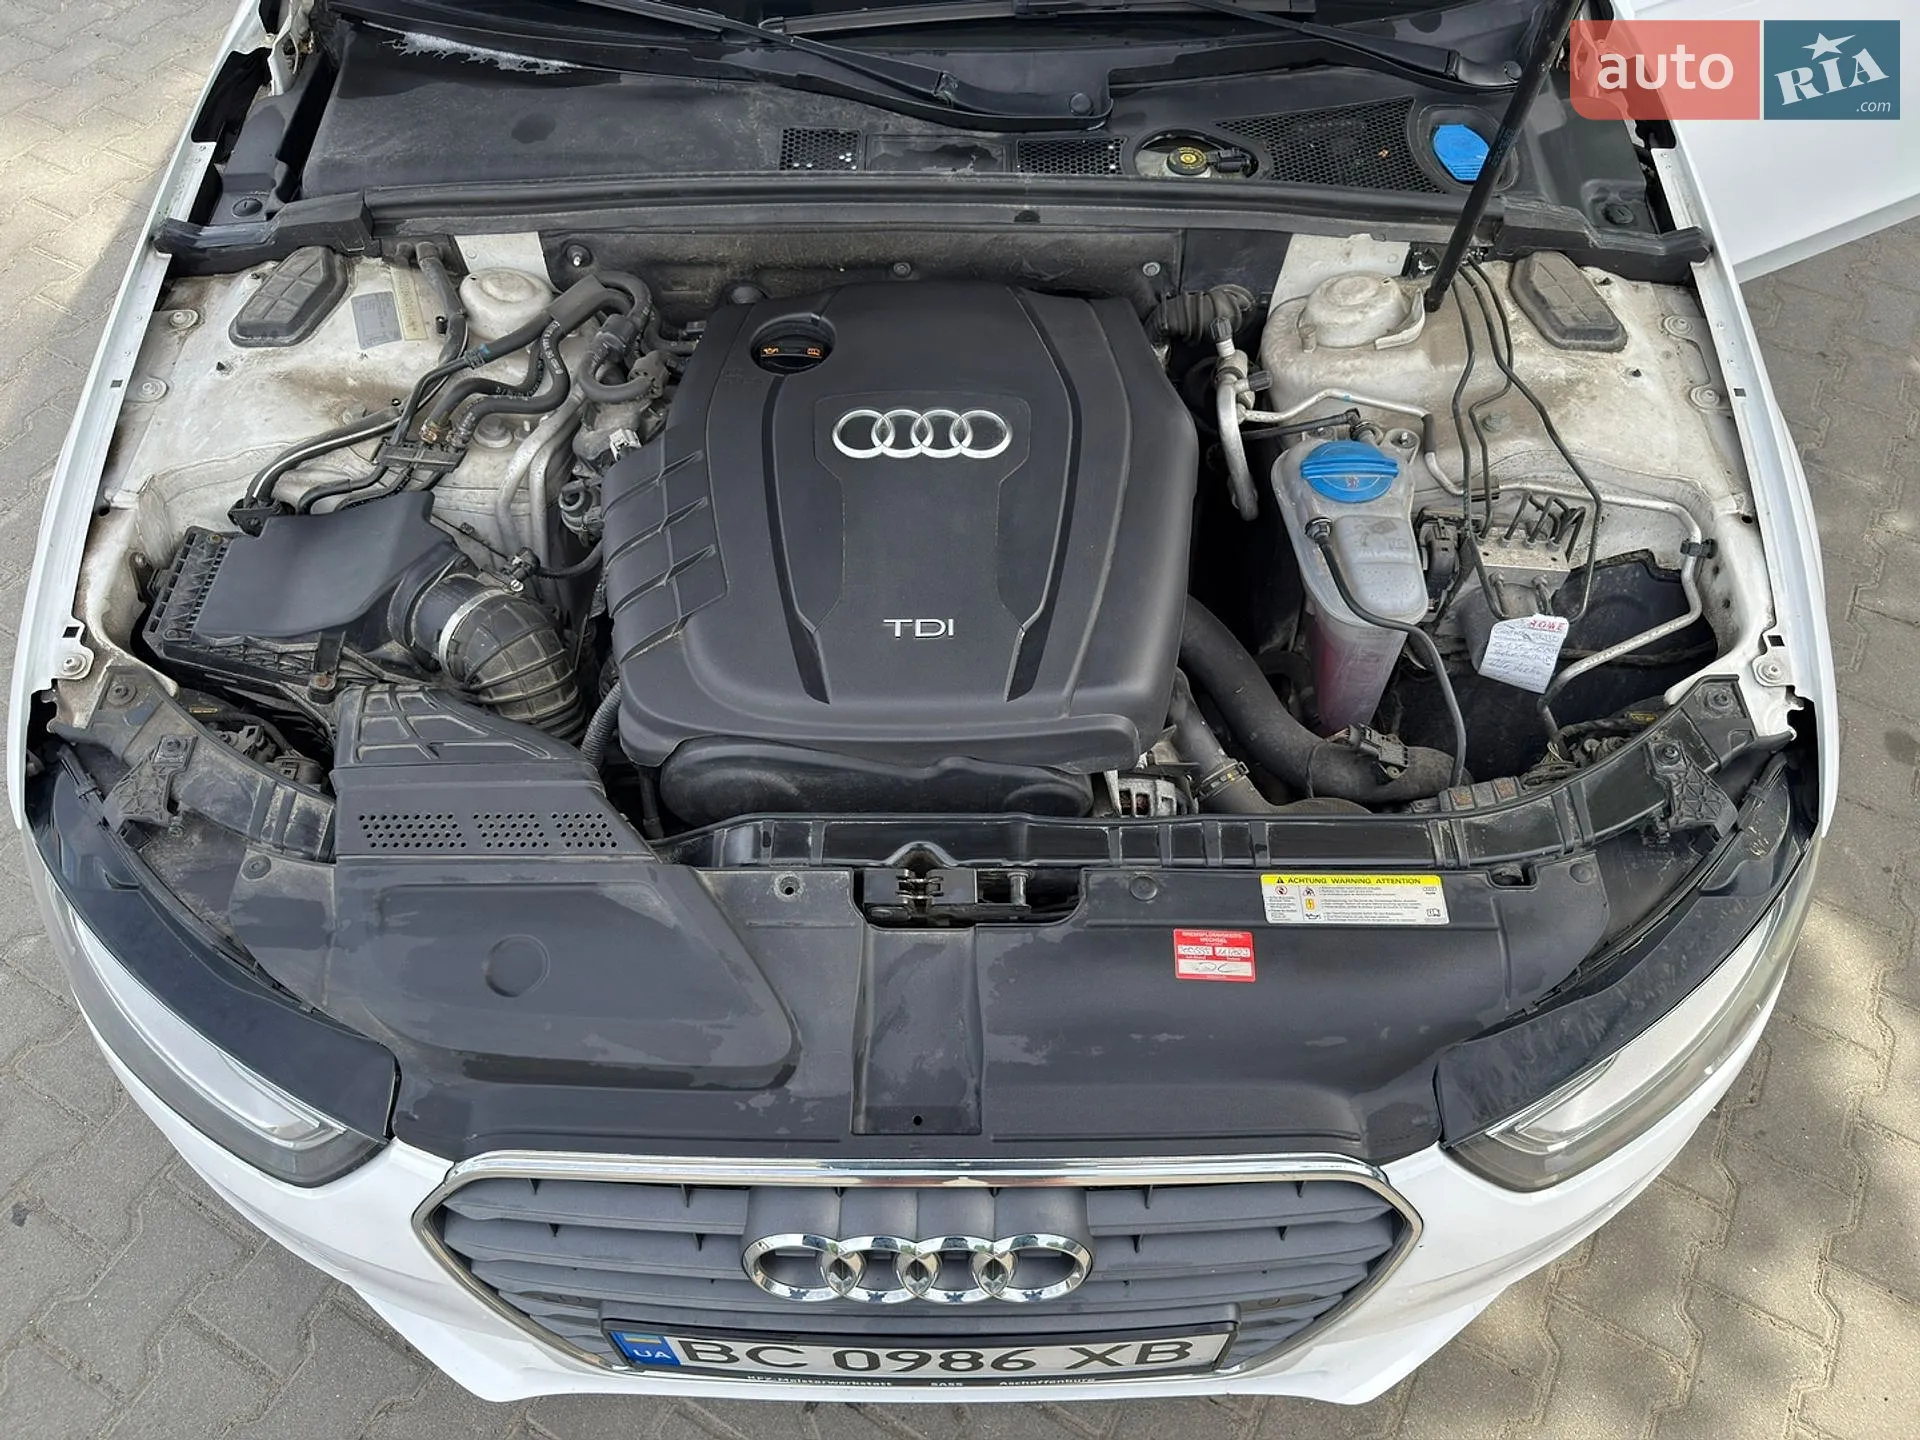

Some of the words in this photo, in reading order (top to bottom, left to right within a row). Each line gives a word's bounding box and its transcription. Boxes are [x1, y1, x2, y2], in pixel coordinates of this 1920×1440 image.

[883, 619, 954, 637] TDI
[1331, 877, 1372, 885] WARNING
[1376, 877, 1421, 885] ATTENTION
[633, 1349, 671, 1359] UA
[678, 1340, 808, 1368] BC
[832, 1348, 1037, 1372] 0986
[1065, 1341, 1194, 1370] XB
